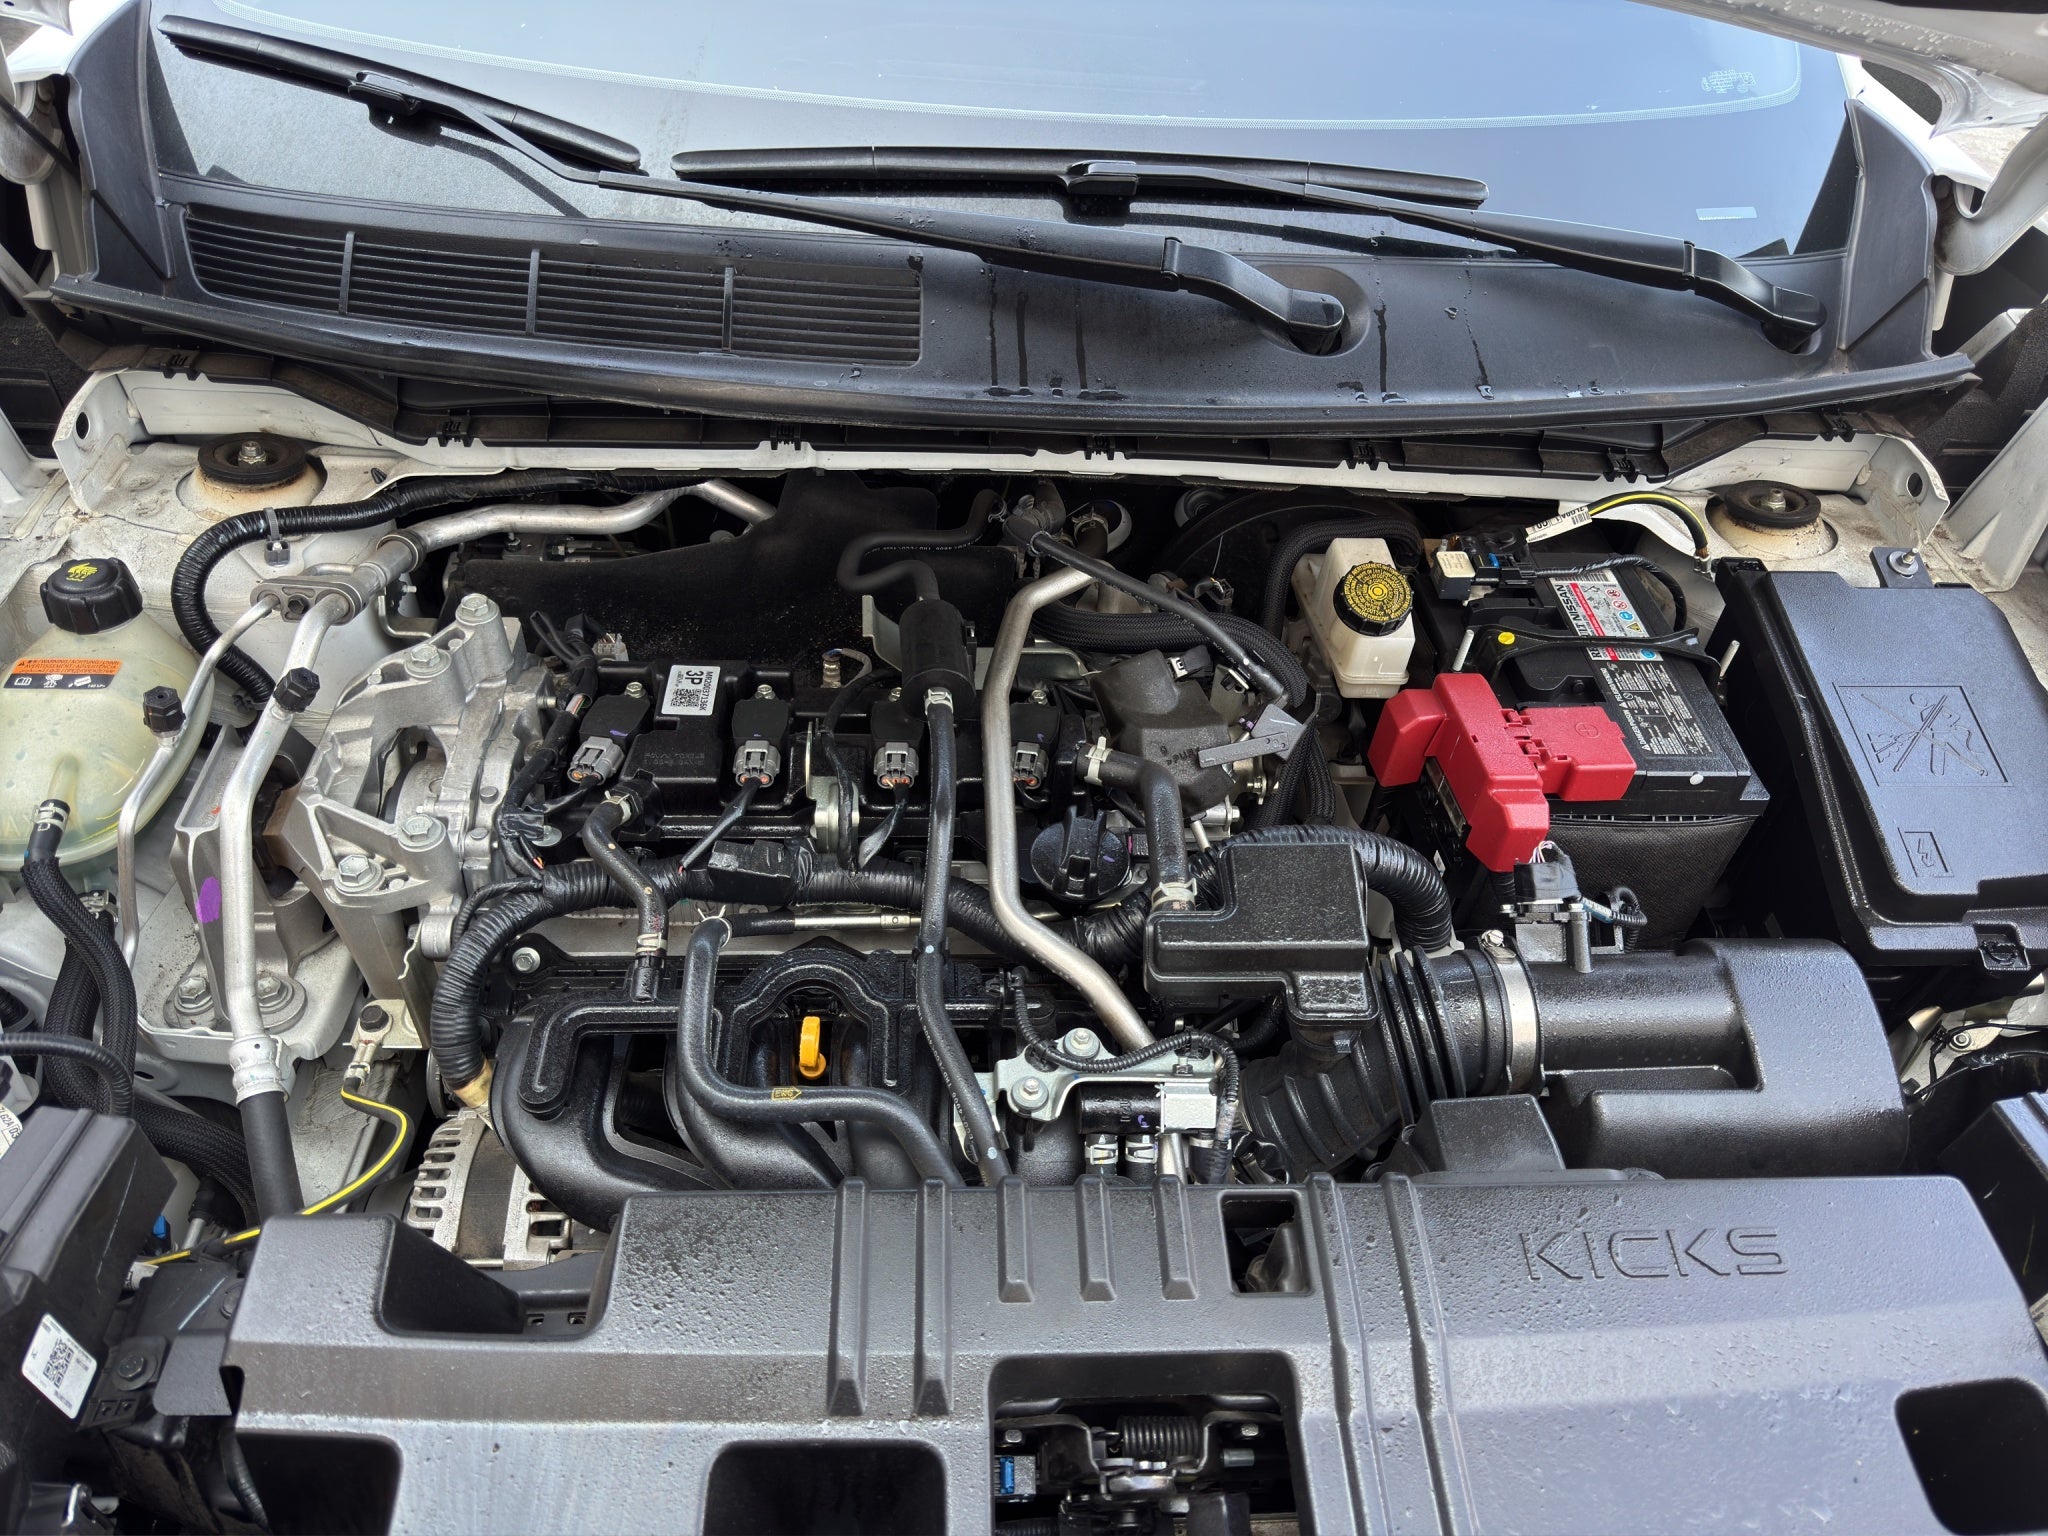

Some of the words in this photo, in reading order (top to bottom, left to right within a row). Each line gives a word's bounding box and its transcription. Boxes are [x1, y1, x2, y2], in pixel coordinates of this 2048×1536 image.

[1555, 584, 1583, 622] NISSAN
[685, 670, 704, 685] 3P
[1518, 1227, 1789, 1281] KICKS
